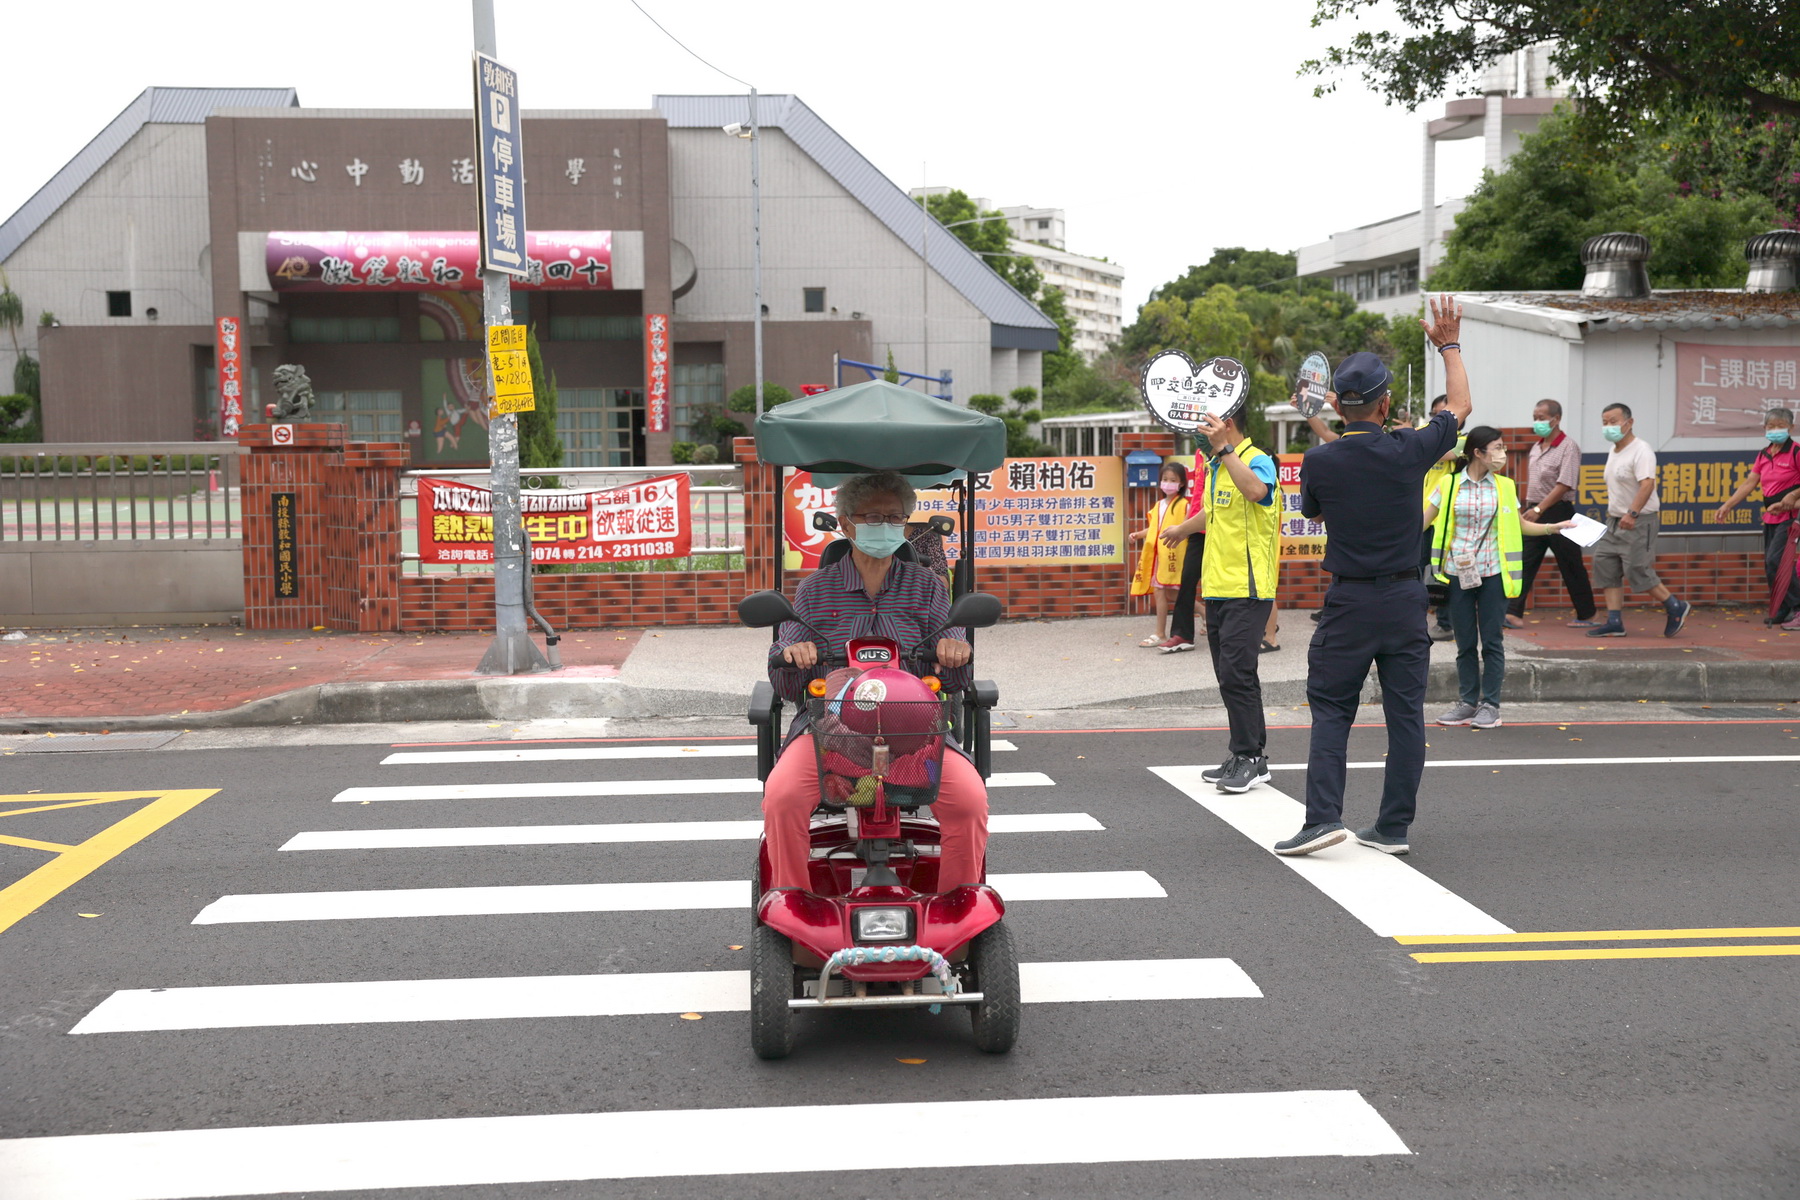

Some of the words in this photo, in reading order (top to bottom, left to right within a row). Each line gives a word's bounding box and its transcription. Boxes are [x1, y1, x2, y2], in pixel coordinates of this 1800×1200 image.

[491, 134, 517, 250] 停車場
[1692, 356, 1797, 391] 上課時間
[1008, 461, 1096, 492] 賴柏佑
[913, 497, 1115, 512] 19年全青少年羽球分齡排名賽
[433, 514, 588, 541] 熱烈生中
[596, 506, 676, 536] 欲報從速
[987, 512, 1116, 527] U15男子雙打2次冠軍
[945, 528, 1101, 544] 全國中盃男子雙打冠軍
[945, 544, 1116, 560] 全運國男組羽球團體銀牌
[858, 648, 890, 661] WU'S
